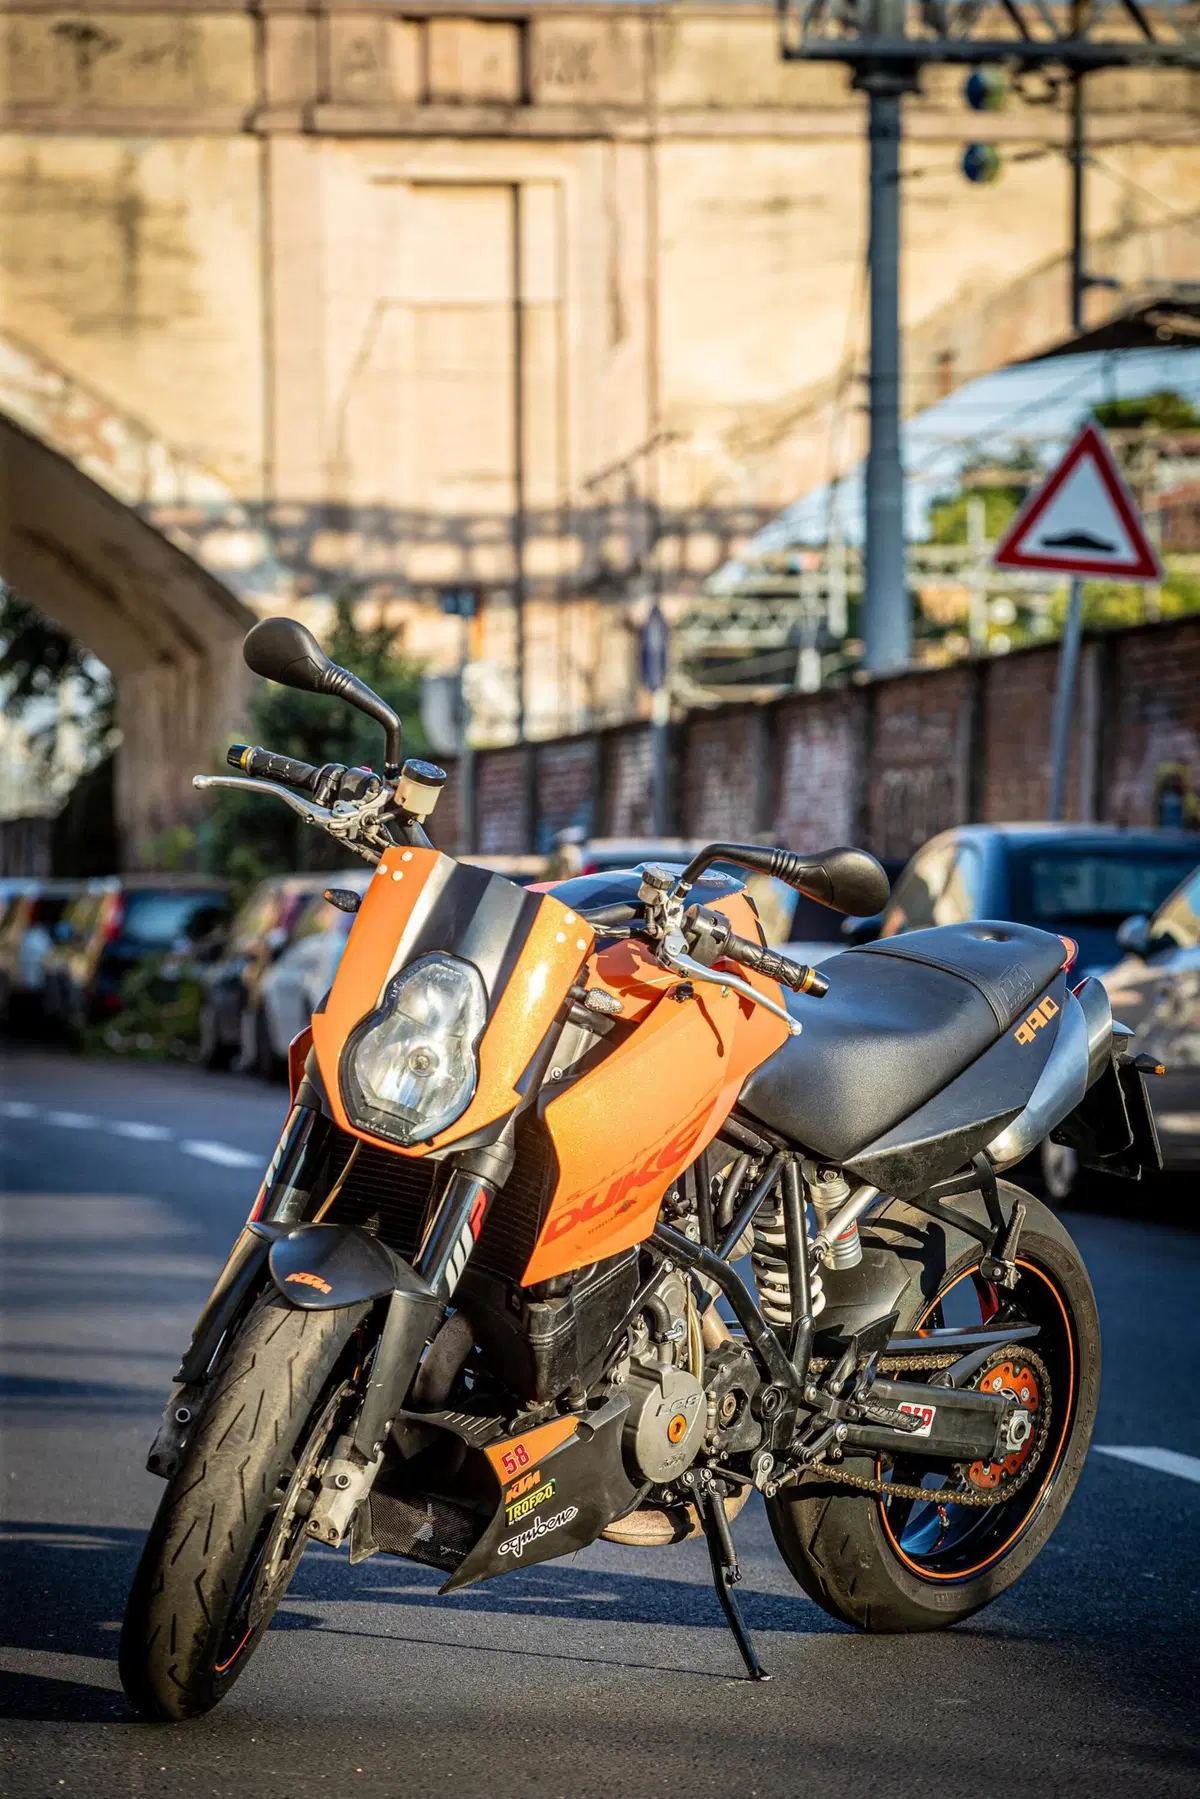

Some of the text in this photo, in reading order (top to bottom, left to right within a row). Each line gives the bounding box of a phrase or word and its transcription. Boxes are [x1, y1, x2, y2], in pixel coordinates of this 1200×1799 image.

[1014, 996, 1059, 1045] 990
[541, 1096, 718, 1247] DUKE
[285, 1272, 333, 1294] KTM
[501, 1443, 530, 1475] 58
[505, 1470, 541, 1504] KTM
